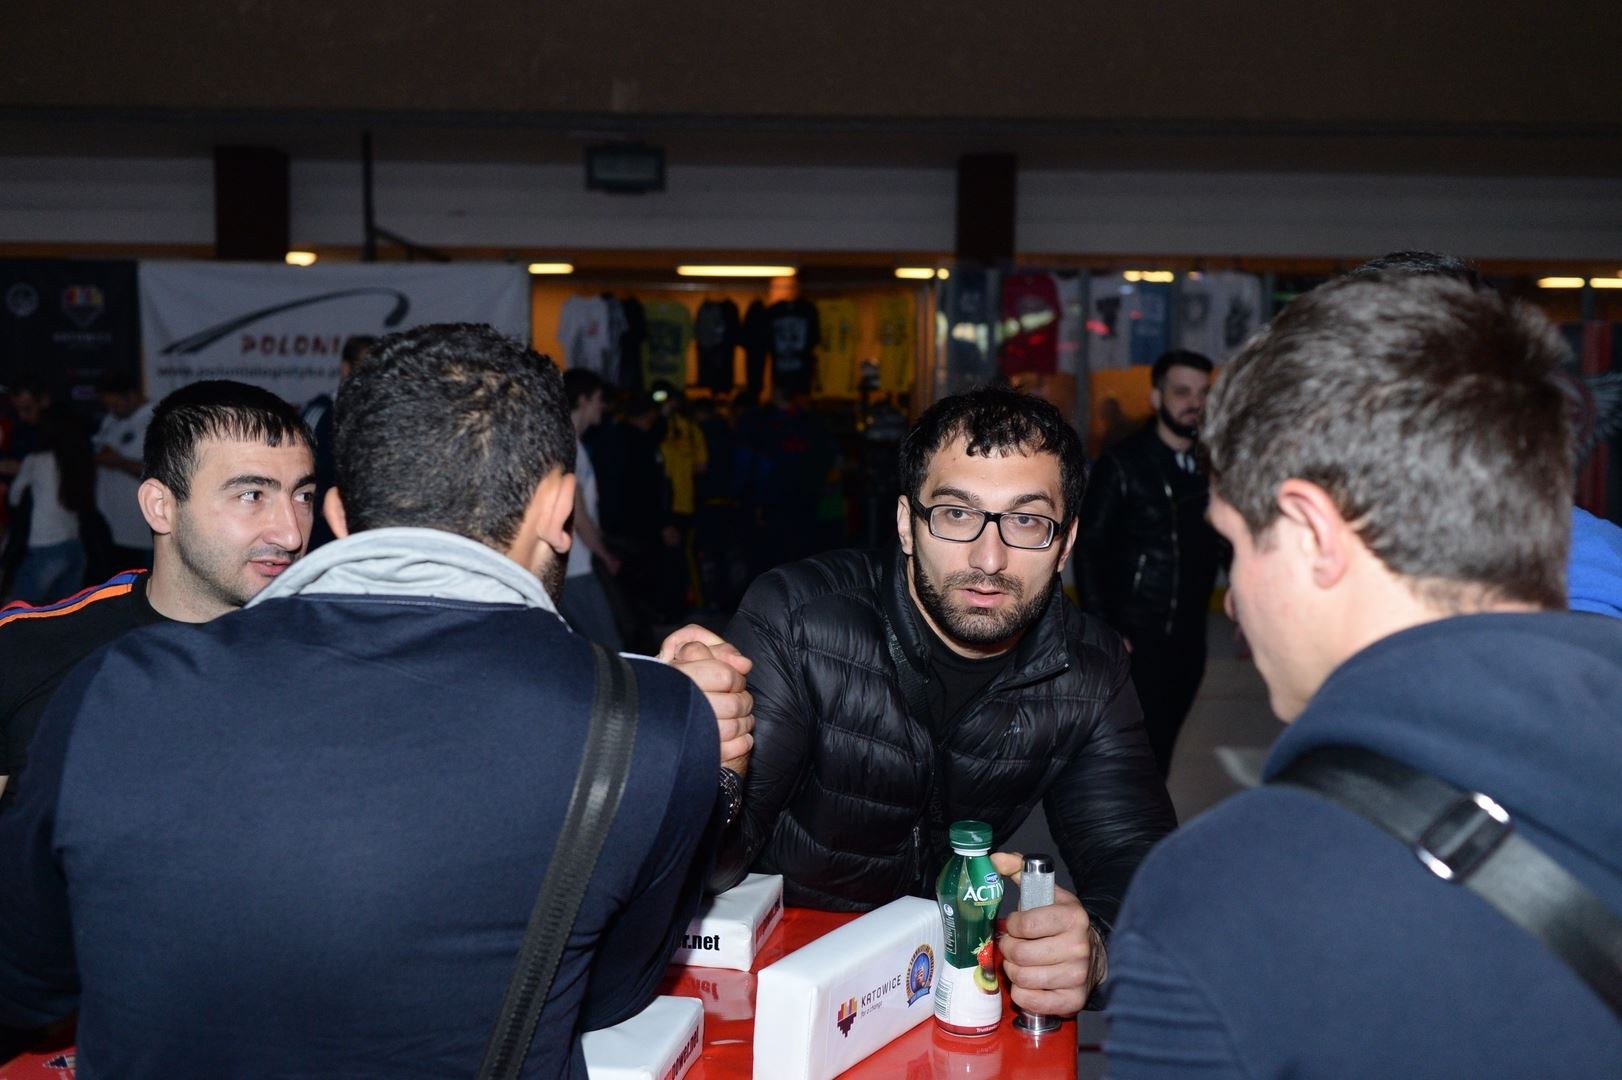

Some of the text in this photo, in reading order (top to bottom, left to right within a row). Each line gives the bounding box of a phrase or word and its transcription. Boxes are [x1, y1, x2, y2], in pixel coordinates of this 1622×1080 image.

[241, 335, 342, 356] POLONI
[681, 934, 720, 951] r.net
[861, 975, 902, 1008] KATOWICE
